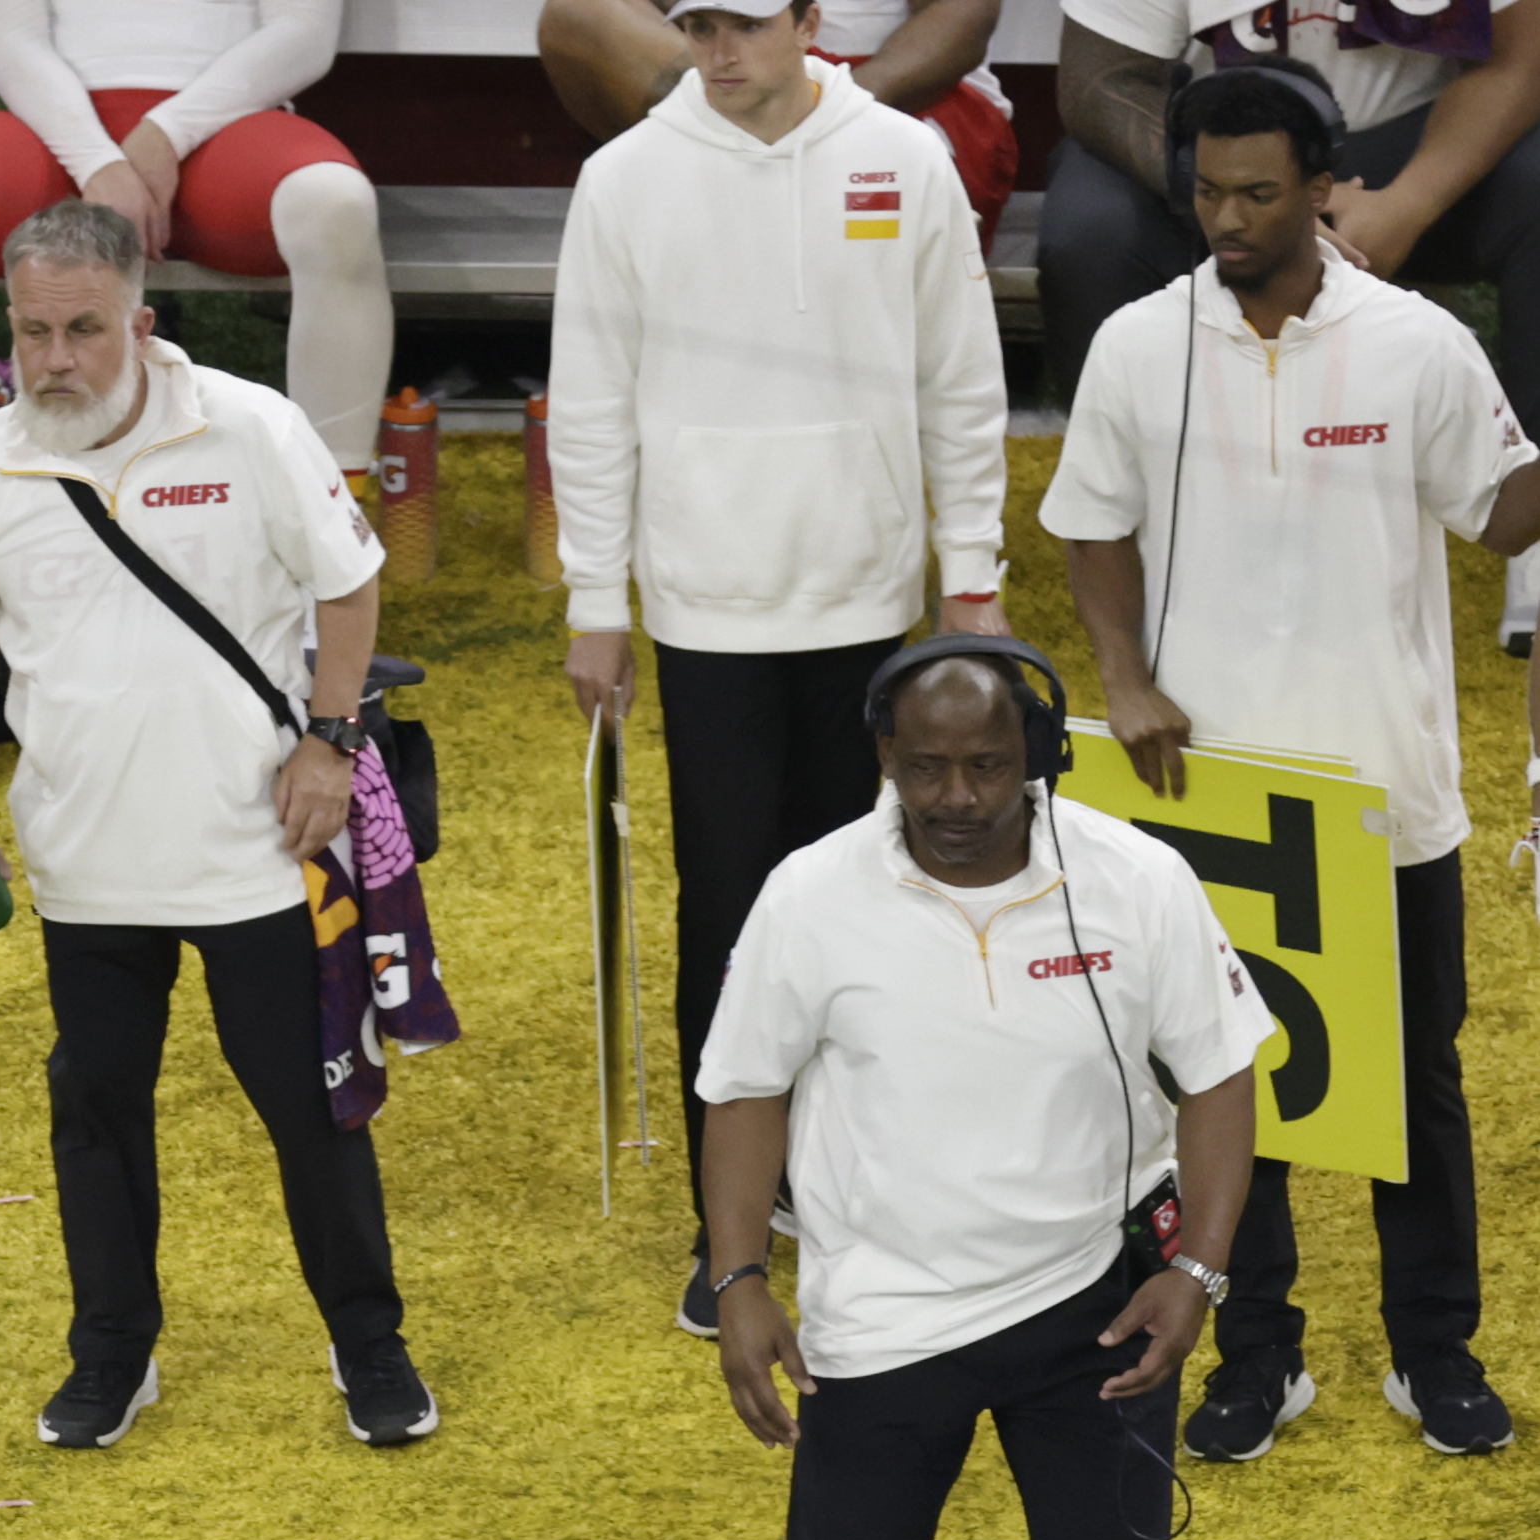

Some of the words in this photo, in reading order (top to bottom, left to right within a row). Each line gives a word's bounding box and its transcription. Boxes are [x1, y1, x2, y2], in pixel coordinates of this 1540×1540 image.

[1303, 423, 1389, 447] CHIEFS
[379, 455, 407, 493] G
[141, 483, 230, 508] CHIEFS
[365, 932, 411, 1010] G
[1027, 950, 1113, 980] CHIEFS
